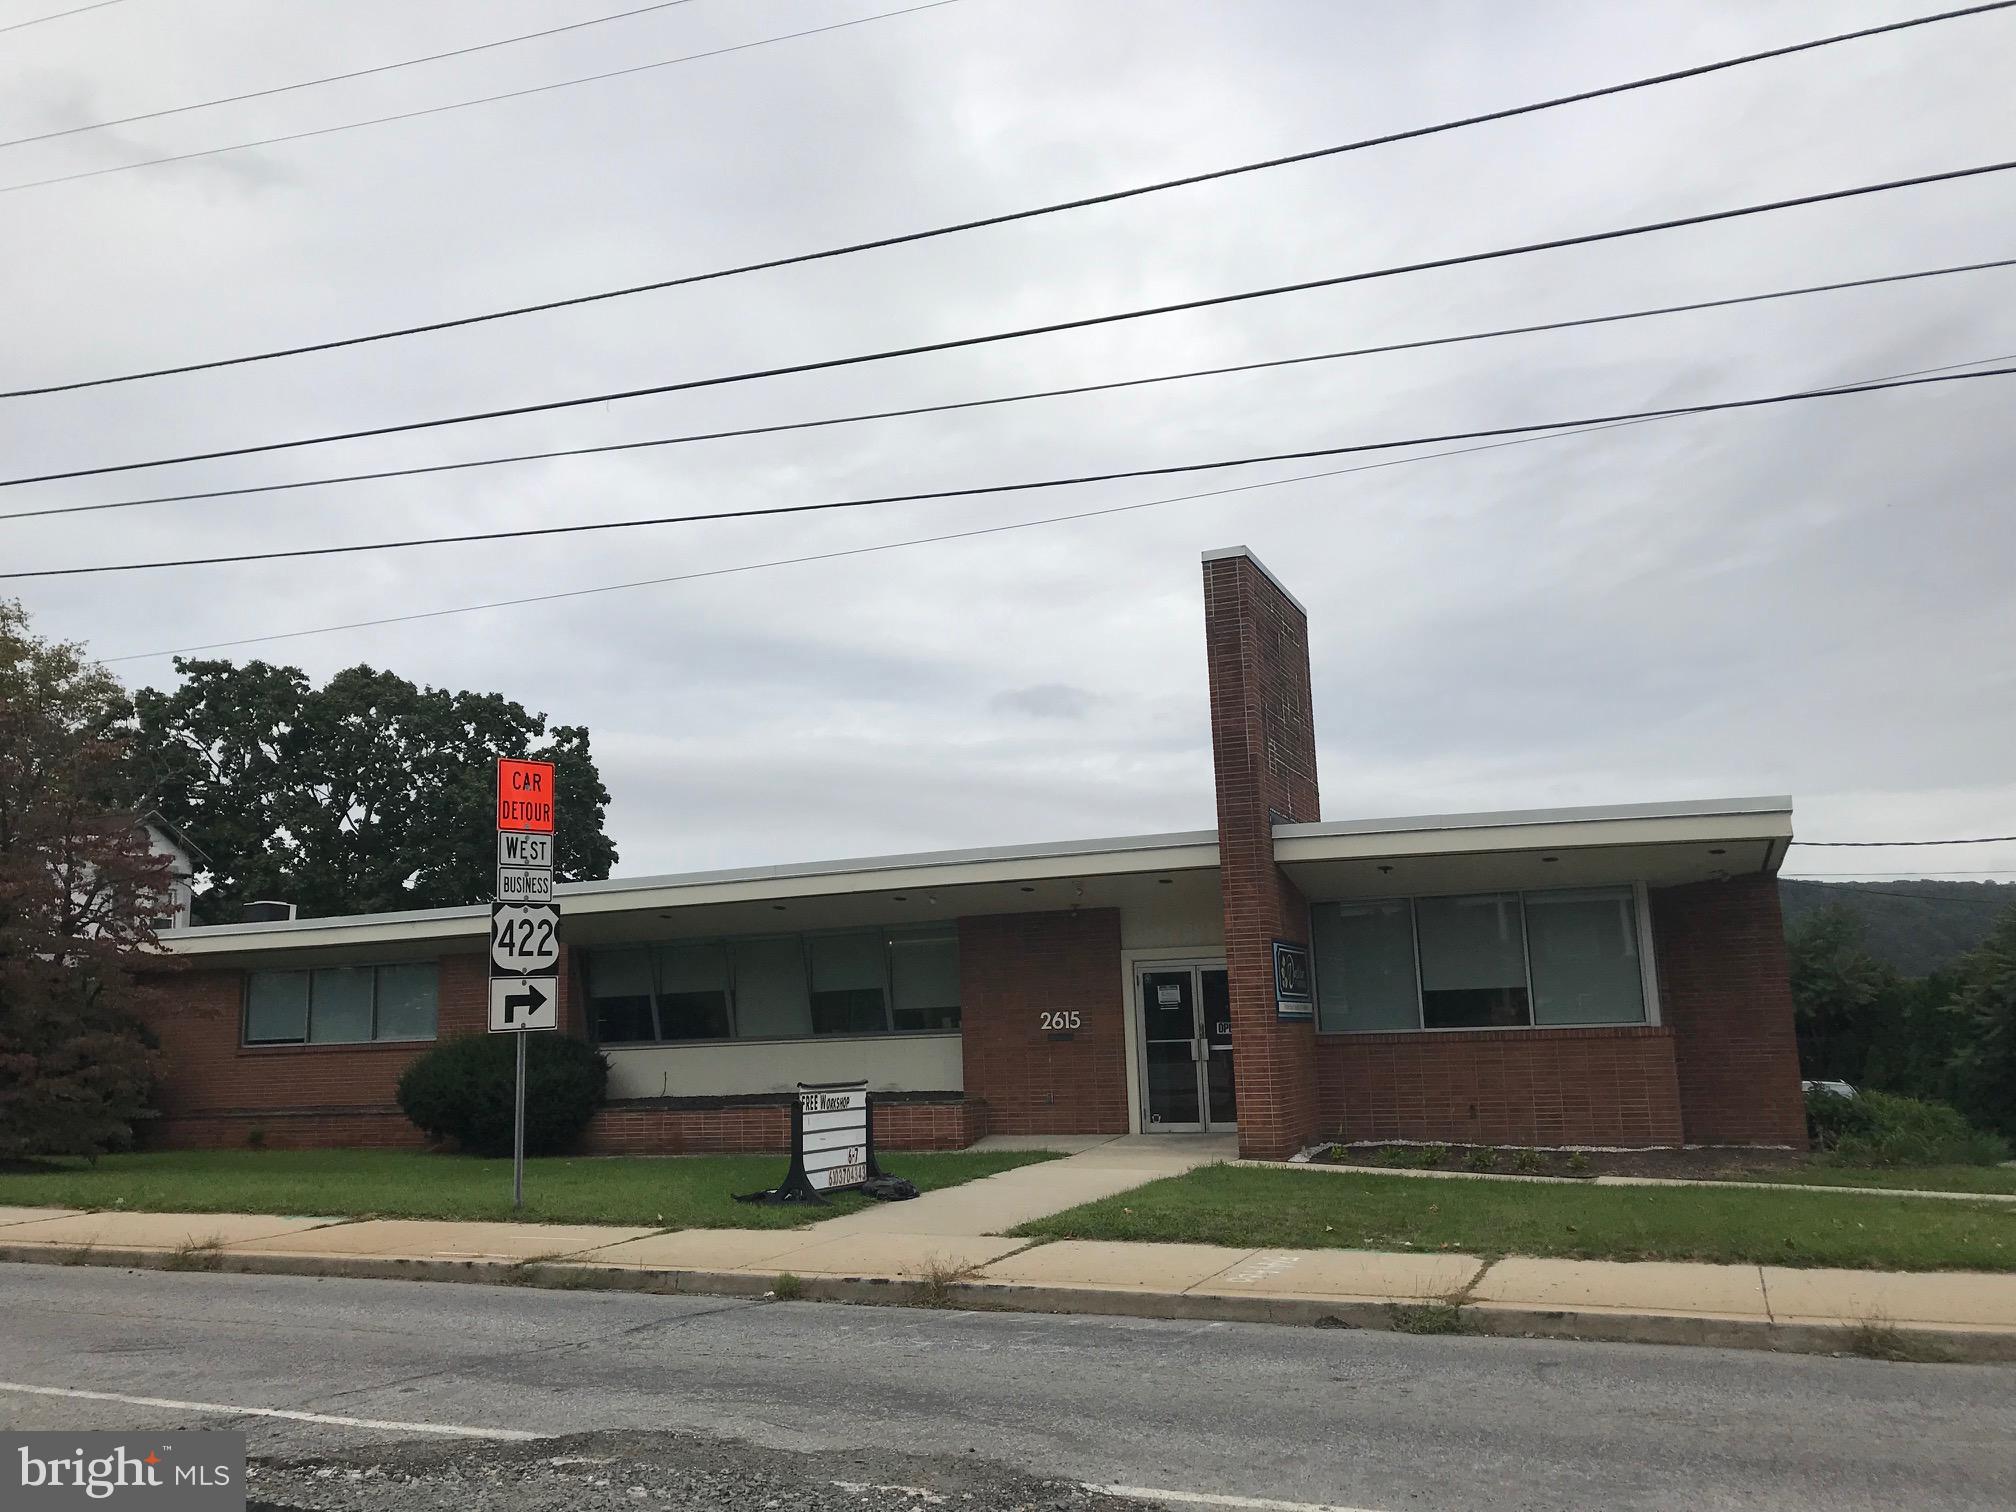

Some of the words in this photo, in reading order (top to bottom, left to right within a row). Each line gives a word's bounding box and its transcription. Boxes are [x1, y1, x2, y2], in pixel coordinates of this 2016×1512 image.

[512, 771, 541, 792] CAR
[502, 800, 550, 822] DETOUR
[505, 836, 547, 860] WEST
[503, 875, 549, 894] BUSINESS
[498, 919, 553, 957] 422
[1040, 1011, 1080, 1030] 2615
[801, 1094, 818, 1111] FREE
